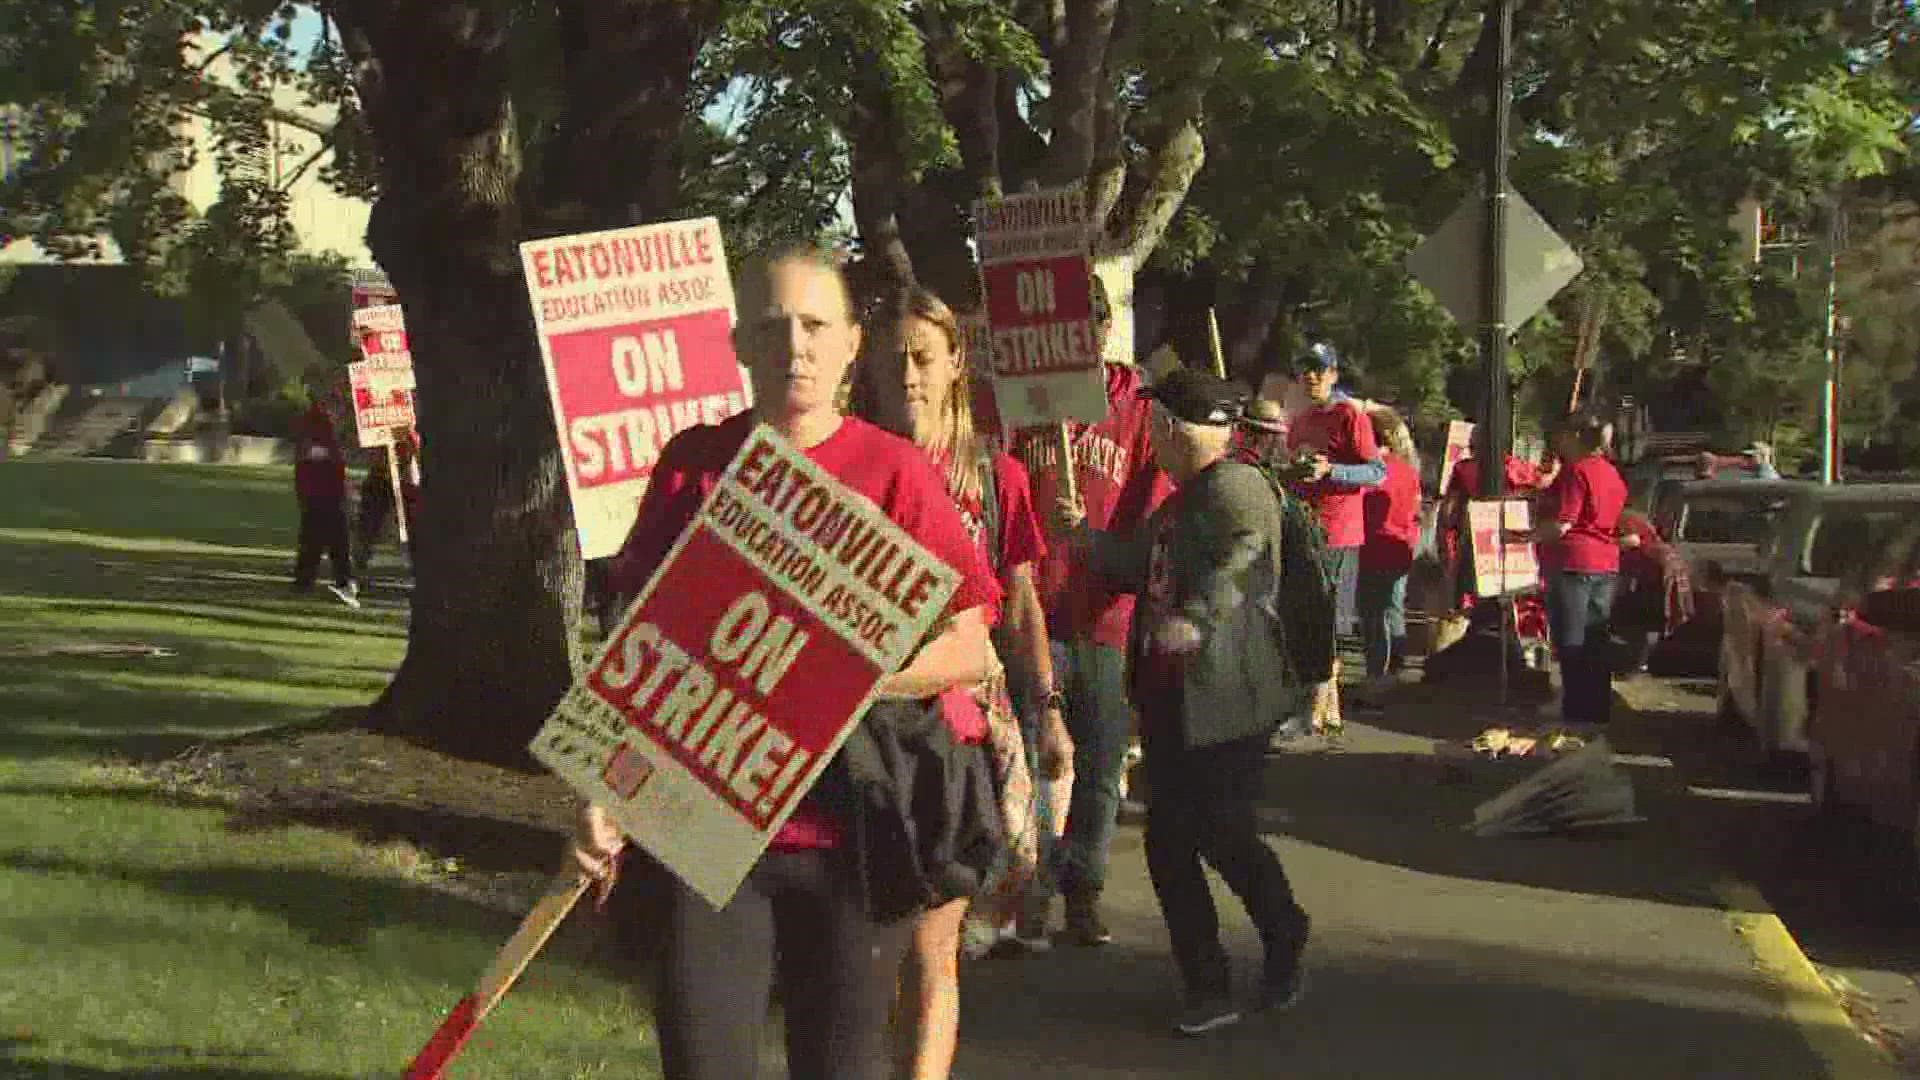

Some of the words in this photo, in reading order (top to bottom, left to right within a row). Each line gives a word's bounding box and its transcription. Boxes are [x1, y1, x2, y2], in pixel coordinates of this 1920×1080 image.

[531, 227, 714, 289] EATONVILLE
[1016, 268, 1057, 315] ON
[611, 328, 685, 398] ON
[707, 487, 828, 598] EDUCATION
[736, 439, 940, 619] EATONVILLE
[711, 591, 811, 697] ON
[600, 621, 813, 828] STRIKE!
